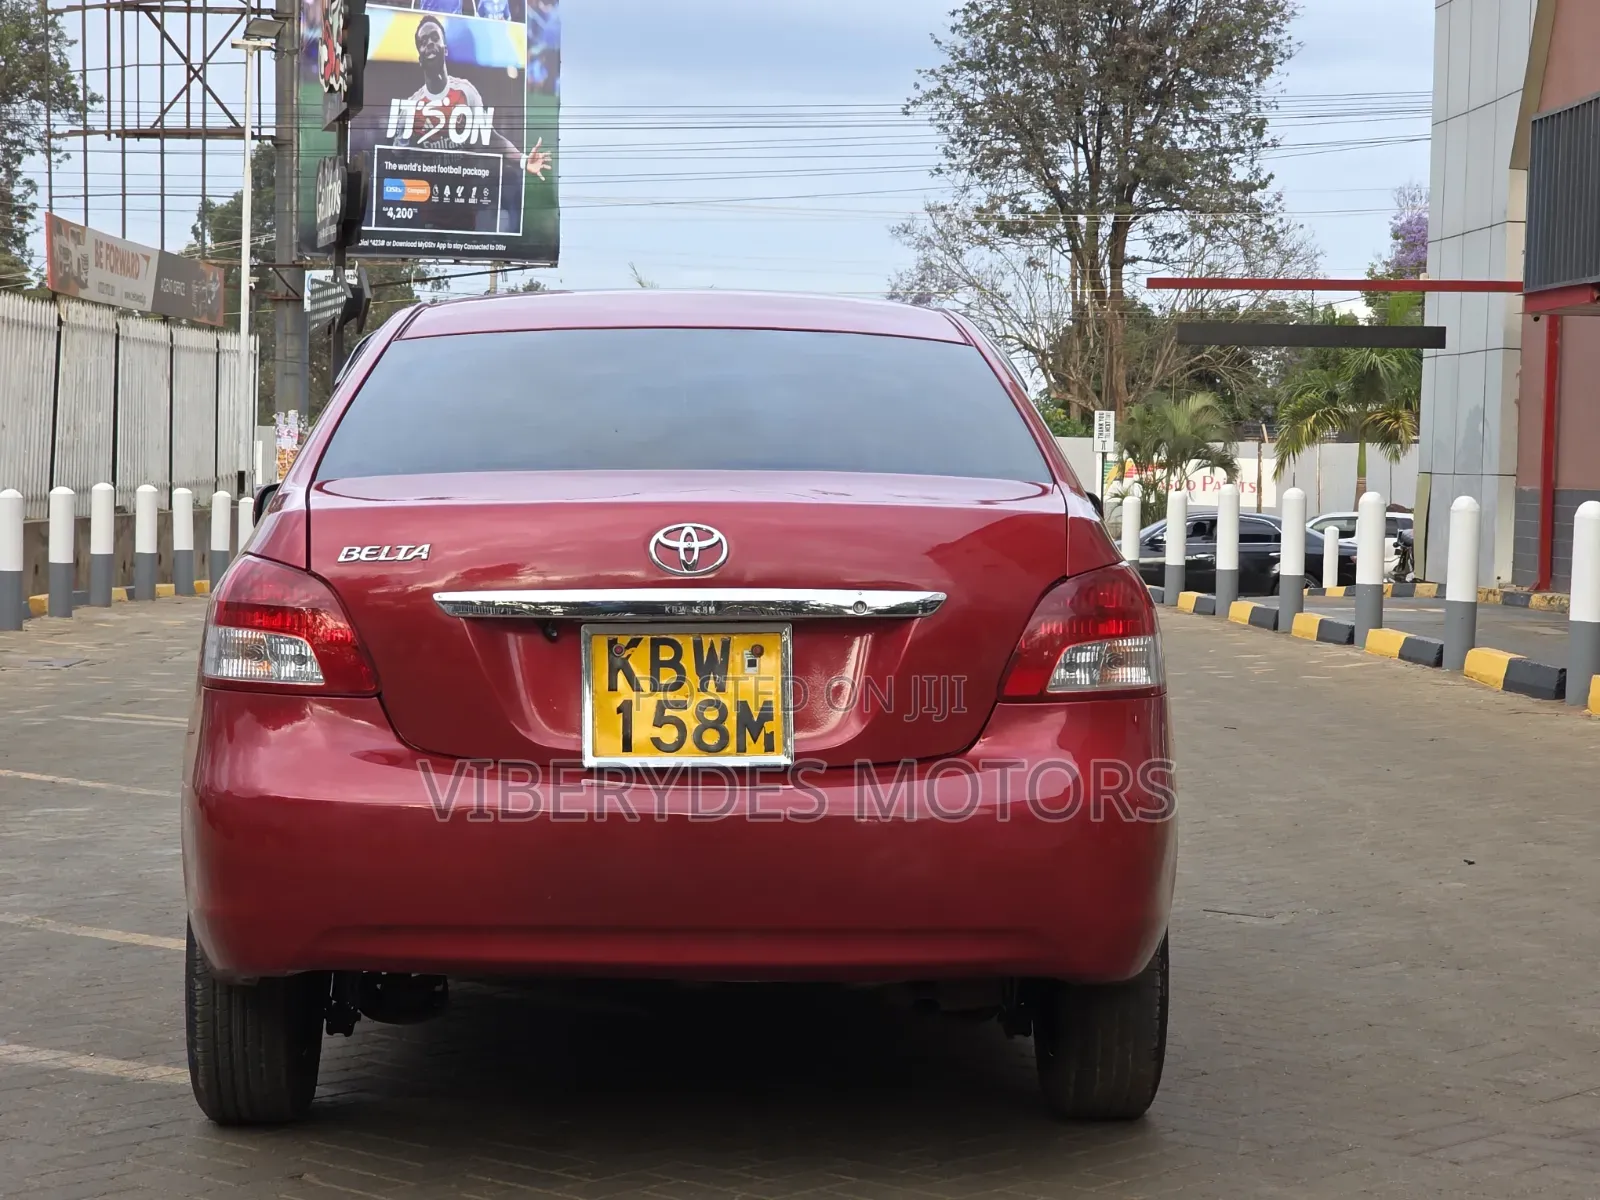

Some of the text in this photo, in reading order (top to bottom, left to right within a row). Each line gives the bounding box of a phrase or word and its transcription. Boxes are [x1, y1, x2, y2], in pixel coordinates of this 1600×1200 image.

[386, 97, 494, 146] IT'S ON
[384, 161, 490, 178] The world's best football package
[387, 206, 413, 220] 4,200
[94, 238, 140, 280] BE FORWARD
[392, 240, 417, 248] Download
[436, 241, 446, 250] App
[453, 242, 463, 251] stay
[464, 242, 489, 251] Connected
[337, 543, 431, 563] BELTA
[607, 636, 731, 693] KBW
[616, 699, 775, 753] 158M
